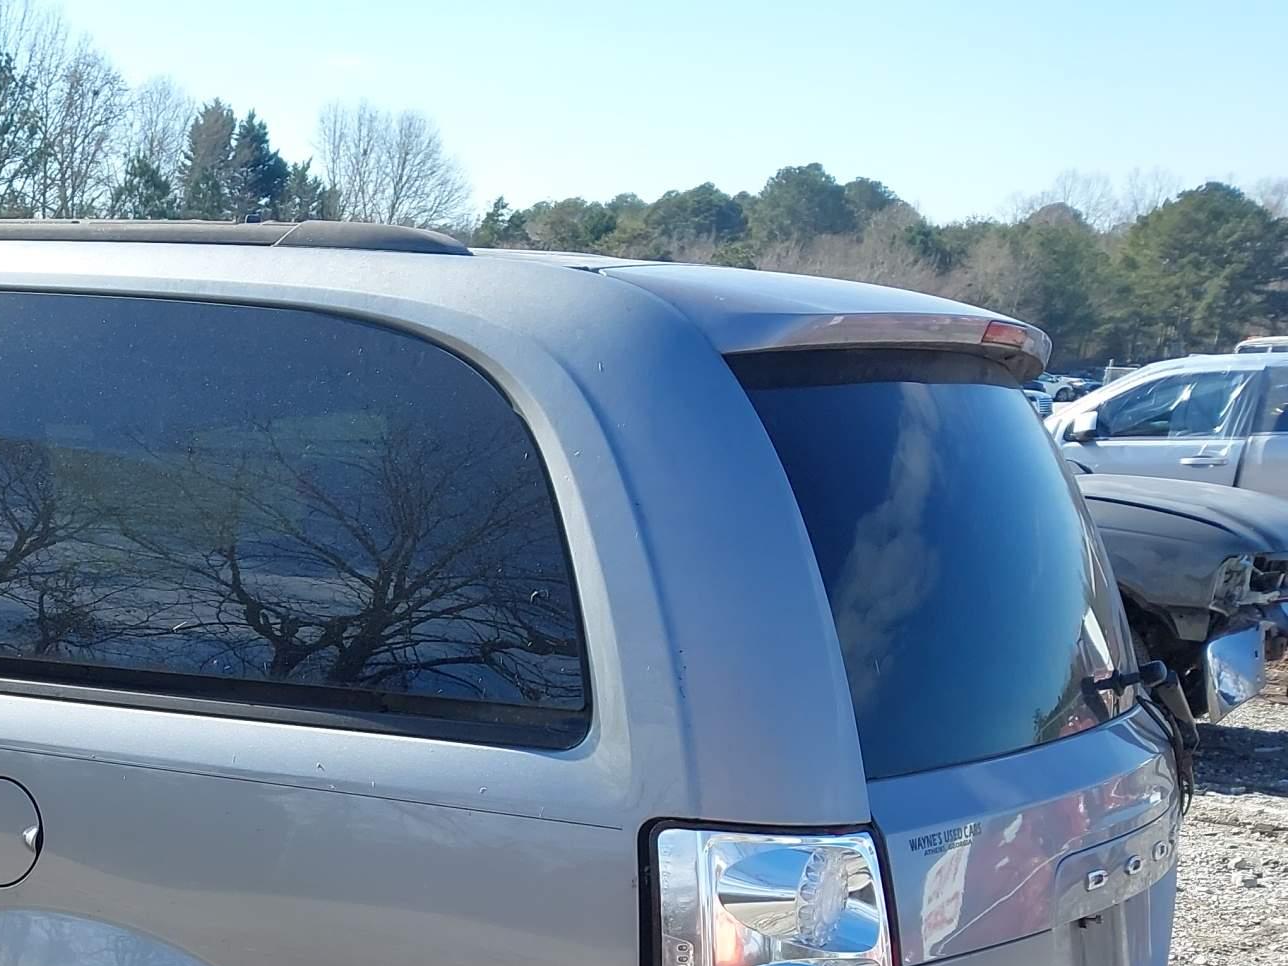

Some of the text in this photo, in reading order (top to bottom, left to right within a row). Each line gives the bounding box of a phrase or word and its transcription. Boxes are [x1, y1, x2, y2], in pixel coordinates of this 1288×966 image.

[909, 822, 982, 852] WAYNE'S USED CARS
